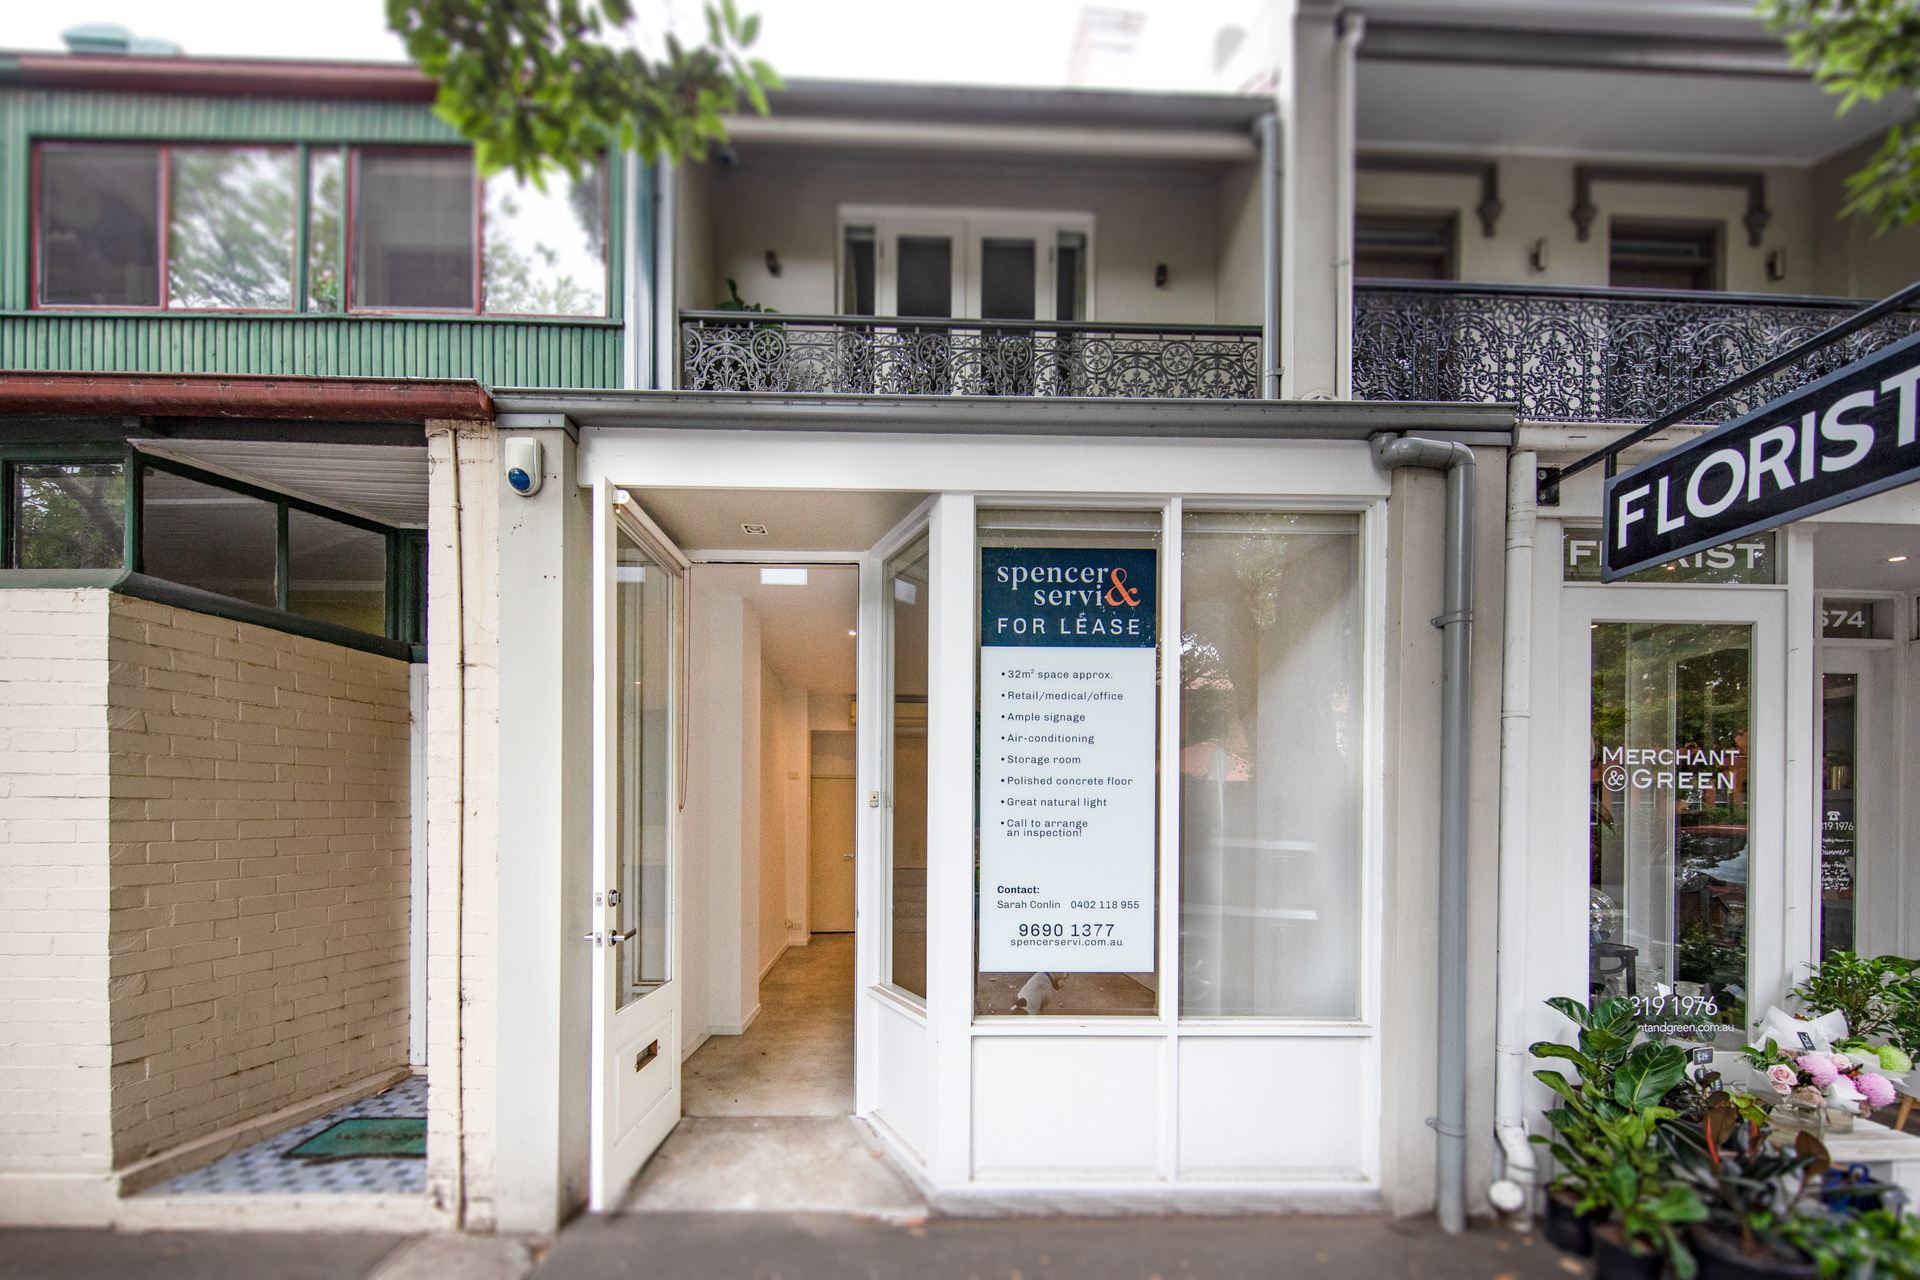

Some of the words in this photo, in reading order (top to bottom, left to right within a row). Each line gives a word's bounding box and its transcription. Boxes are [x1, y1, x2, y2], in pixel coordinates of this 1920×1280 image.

[1617, 366, 1920, 550] FLORIST
[1569, 540, 1765, 569] FIST
[997, 565, 1109, 591] spencer
[1105, 567, 1141, 607] &
[1033, 584, 1103, 606] servi
[997, 617, 1046, 634] FOR
[1060, 617, 1140, 635] LEASE
[1037, 671, 1070, 680] space
[1072, 671, 1113, 680] approx.
[1007, 690, 1124, 702] Retail/medical/office
[1007, 712, 1041, 722] Ample
[1043, 713, 1086, 723] signage
[1007, 733, 1095, 744] Air-conditioning
[1007, 755, 1050, 766] Storage
[1053, 756, 1081, 764] room
[1602, 746, 1740, 766] MERCHANT
[1007, 776, 1053, 786] Polished
[1055, 777, 1104, 786] concrete
[1107, 776, 1133, 786] floor
[1631, 768, 1734, 789] GREEN
[1006, 798, 1037, 807] Great
[1040, 798, 1080, 807] natural
[1083, 798, 1107, 809] light
[1006, 819, 1027, 828] Call
[1031, 819, 1041, 828] to
[1044, 820, 1089, 830] arrange
[1835, 821, 1854, 831] 1976
[1006, 829, 1020, 837] an
[1023, 828, 1082, 838] inspection!
[997, 885, 1040, 894] Contact:
[997, 900, 1027, 909] Sarah
[1029, 900, 1061, 909] Conlin
[1070, 900, 1096, 909] 0402
[1099, 900, 1118, 909] 118
[1120, 900, 1140, 909] 955
[1018, 923, 1064, 937] 9690
[1070, 923, 1115, 937] 1377
[1010, 937, 1123, 947] spencerservi.com.au
[1671, 996, 1718, 1016] 1976
[1637, 1021, 1735, 1035] ntandgreen.com.au
